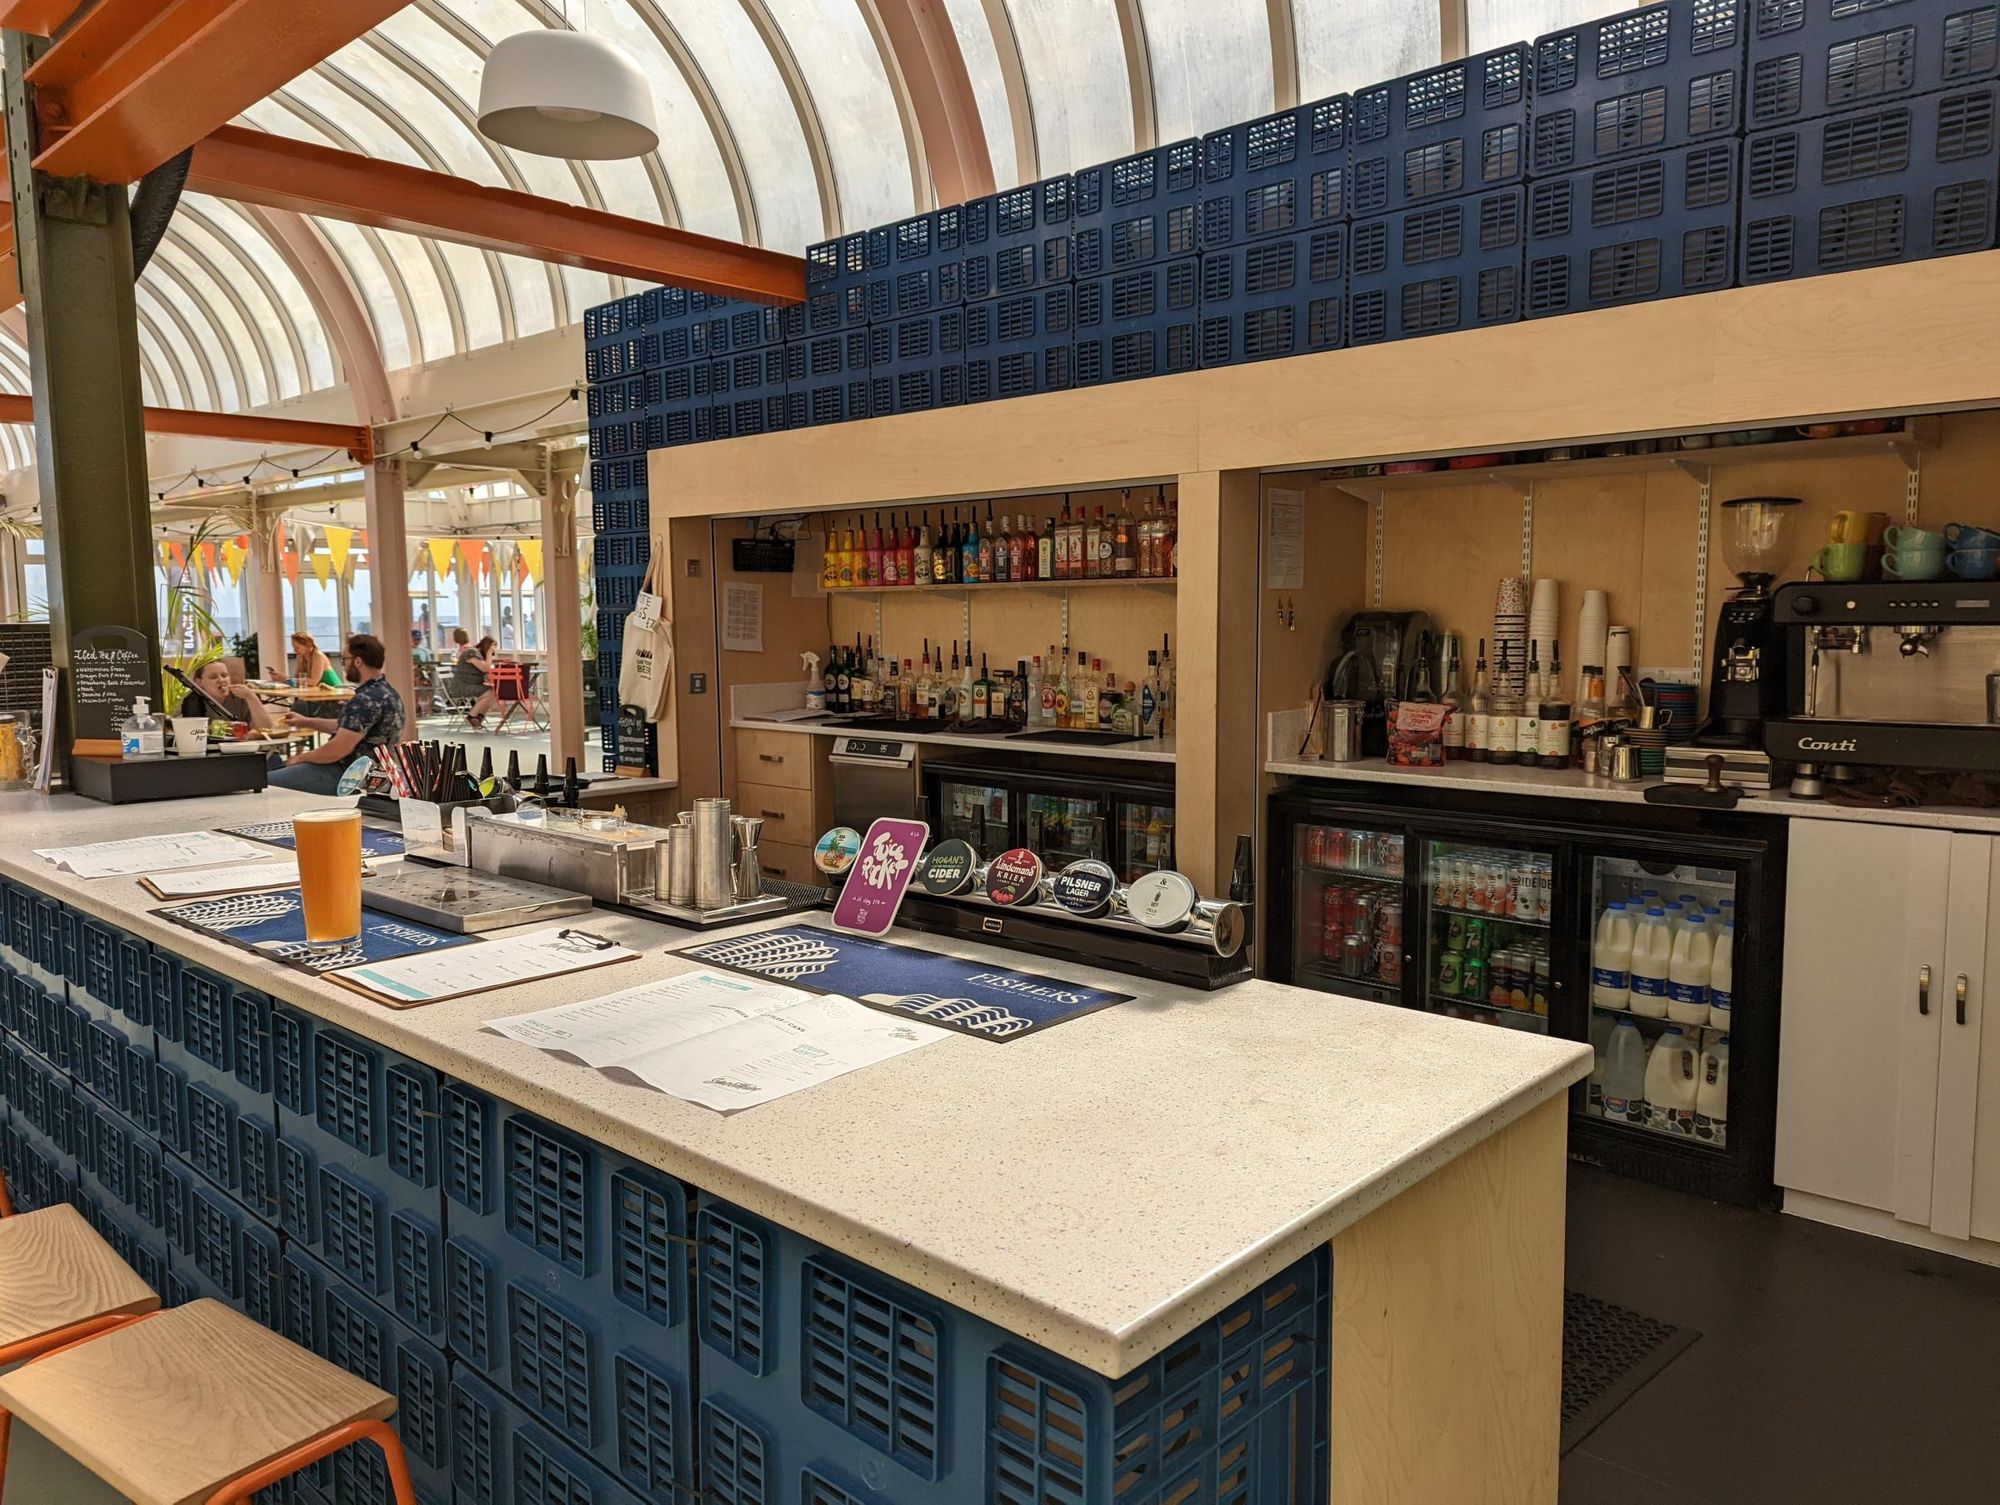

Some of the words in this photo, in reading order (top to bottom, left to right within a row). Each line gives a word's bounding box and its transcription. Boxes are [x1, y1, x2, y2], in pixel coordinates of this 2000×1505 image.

[116, 650, 139, 661] Coffee
[1798, 737, 1857, 752] Conti
[872, 832, 904, 861] Juice
[931, 856, 964, 865] HOGAN'S
[927, 868, 961, 879] CIDER
[996, 870, 1026, 884] KRIEK
[1060, 876, 1102, 892] PILSNER
[1066, 886, 1089, 897] LAGER
[965, 973, 1091, 1004] FISHERS
